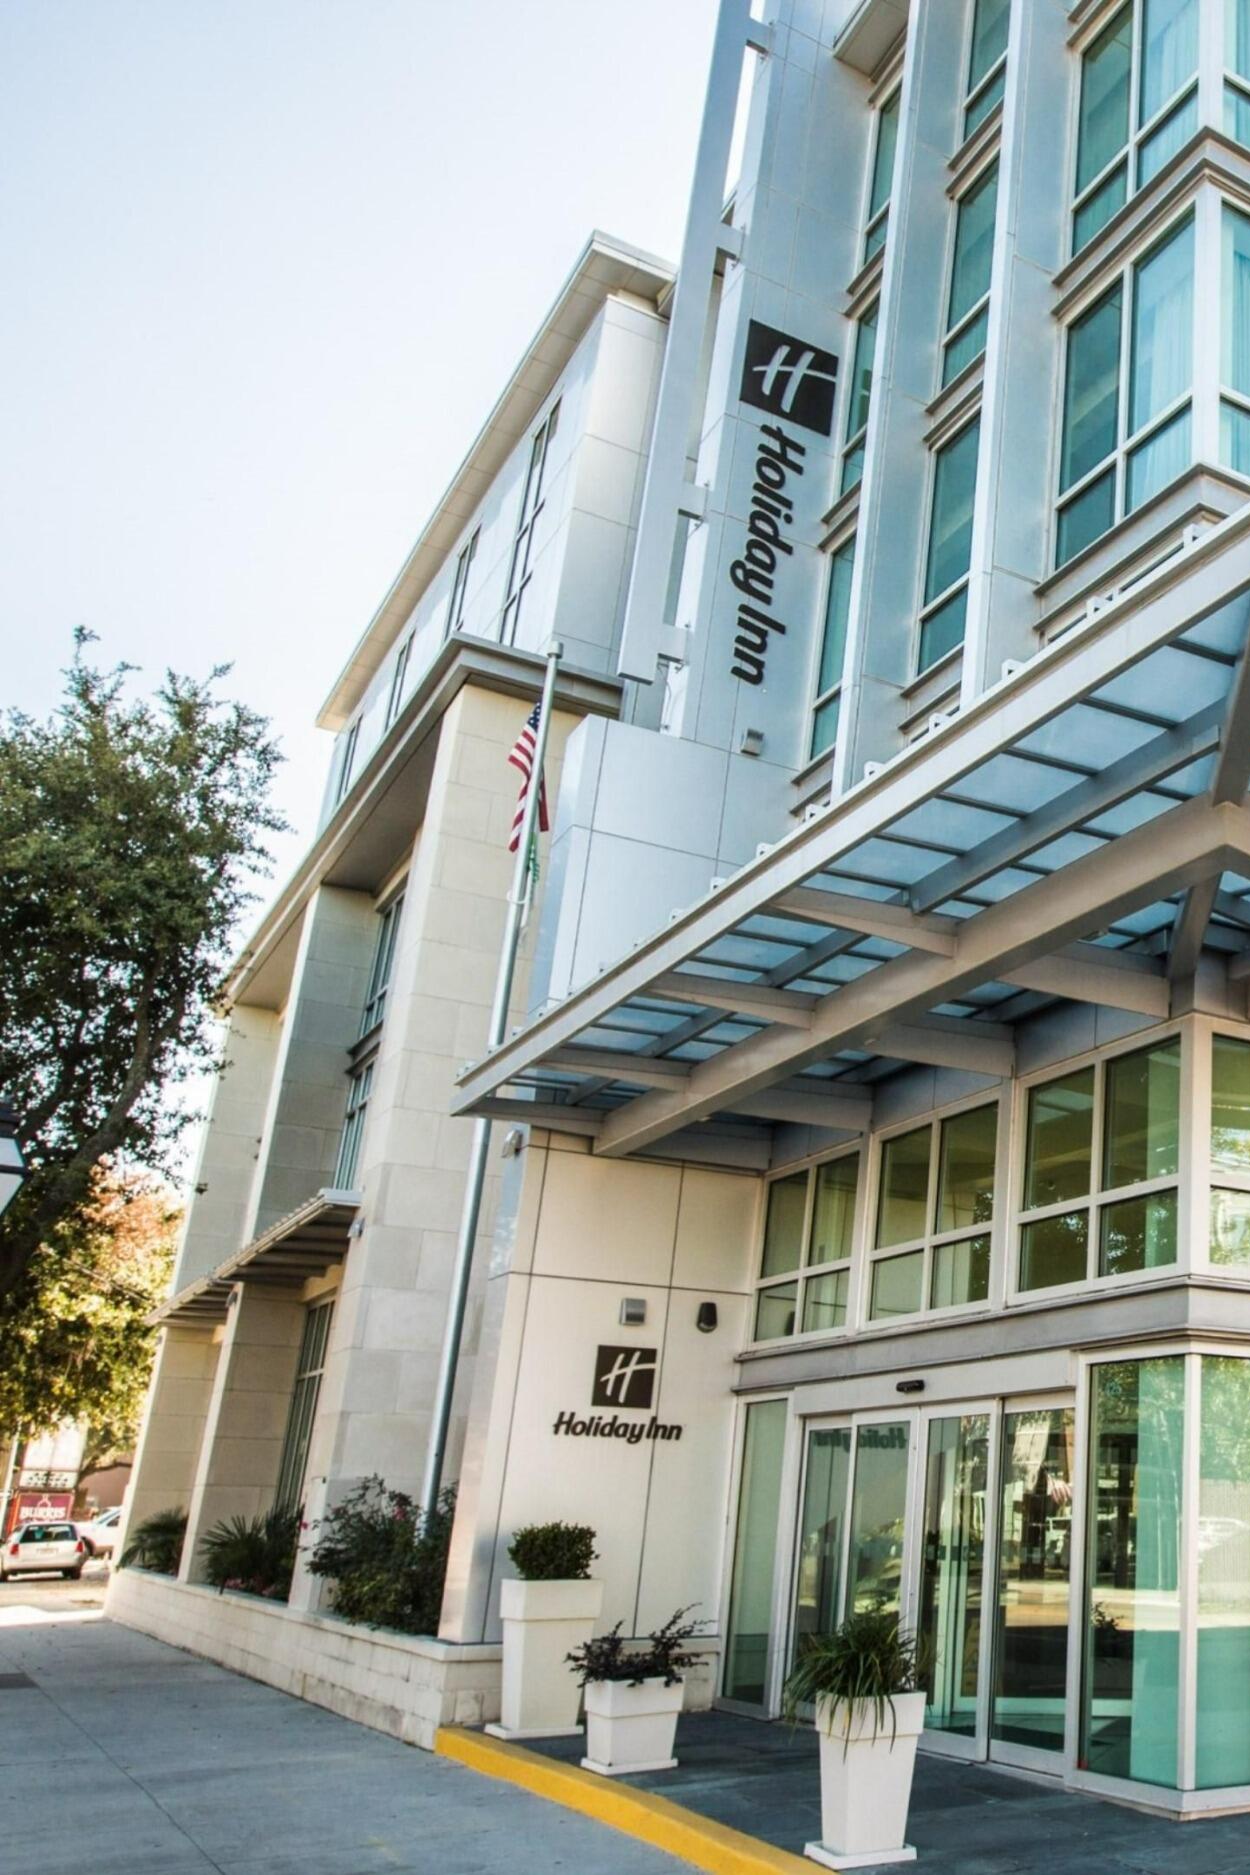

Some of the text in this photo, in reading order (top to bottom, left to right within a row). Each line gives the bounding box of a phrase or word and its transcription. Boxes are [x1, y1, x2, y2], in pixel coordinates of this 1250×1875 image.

[730, 424, 806, 686] Holiday Inn
[552, 1411, 683, 1444] Holiday Inn
